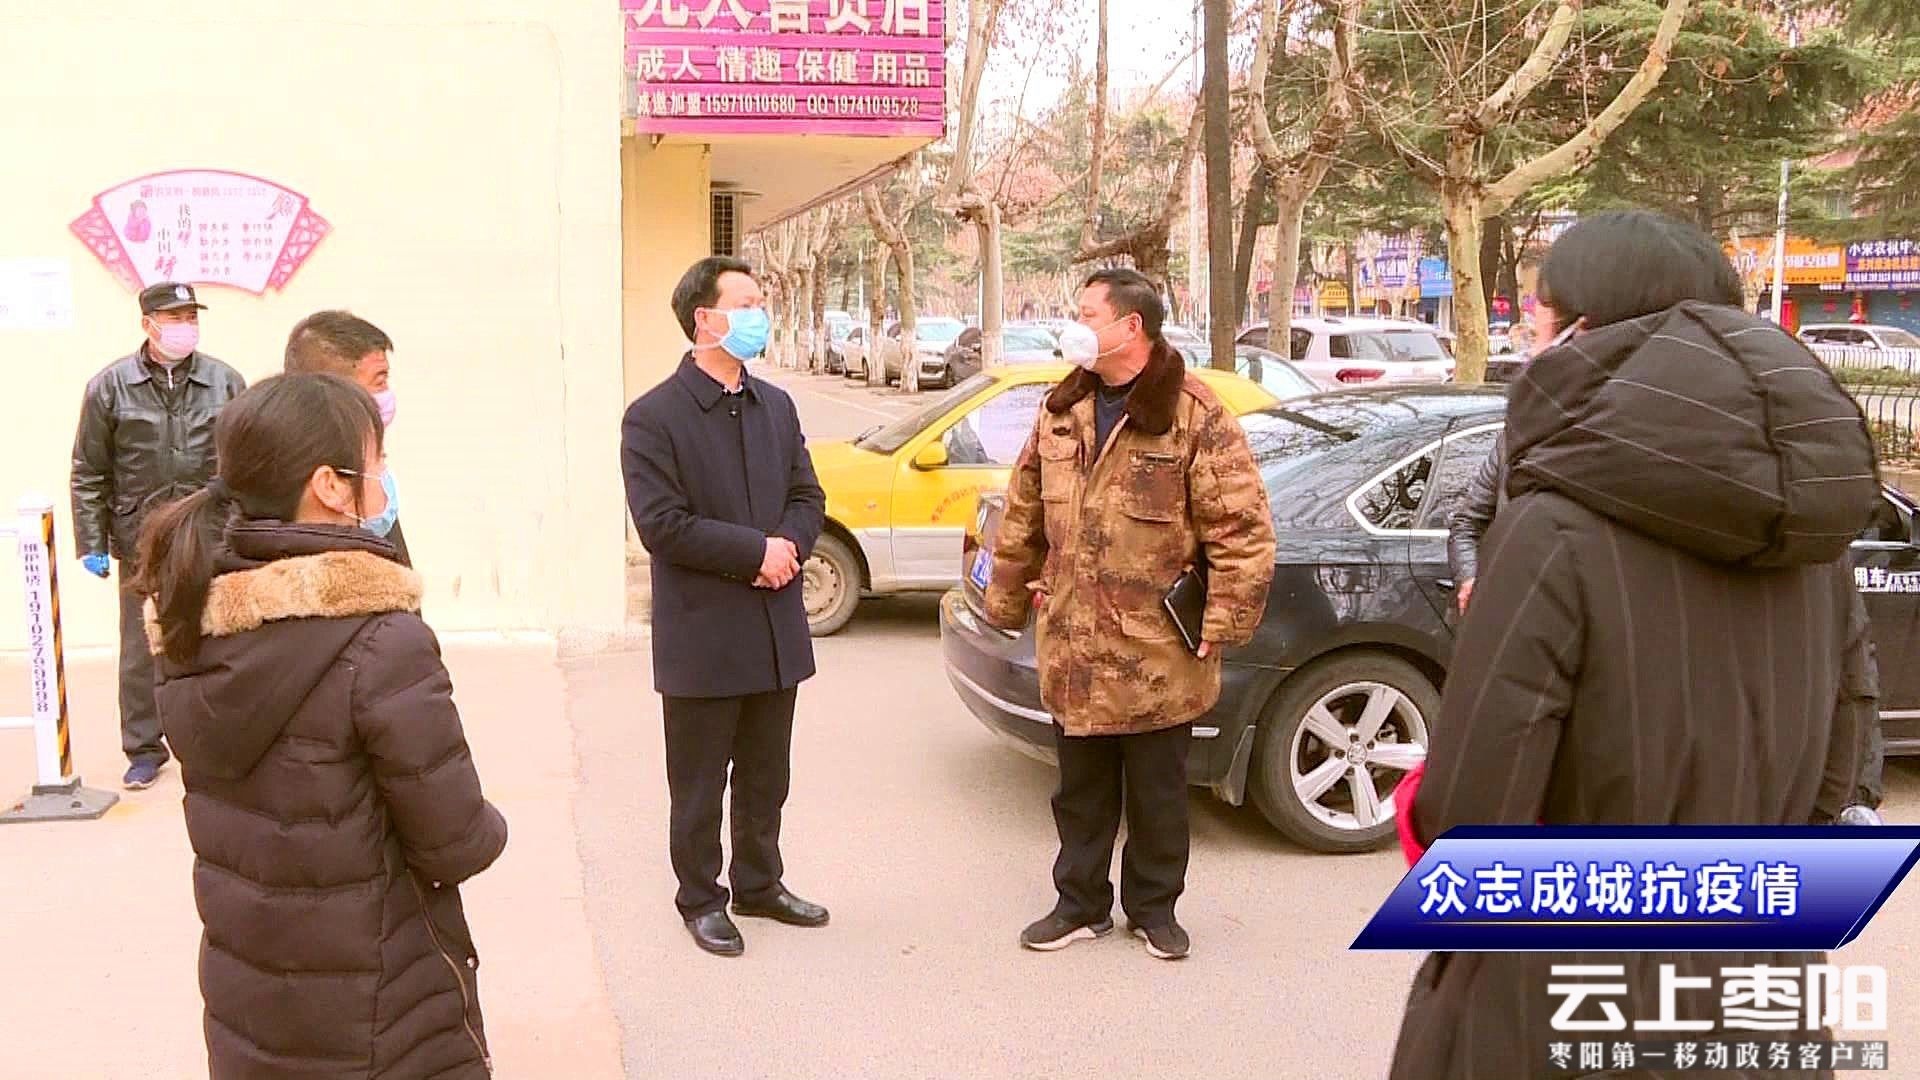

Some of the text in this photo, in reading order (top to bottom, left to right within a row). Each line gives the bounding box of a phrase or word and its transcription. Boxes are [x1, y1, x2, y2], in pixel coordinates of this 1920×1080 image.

[636, 49, 929, 86] 成人 情趣 保健 用品
[705, 95, 796, 114] 15971010680
[807, 94, 828, 114] QQ
[832, 96, 919, 117] 1974109528
